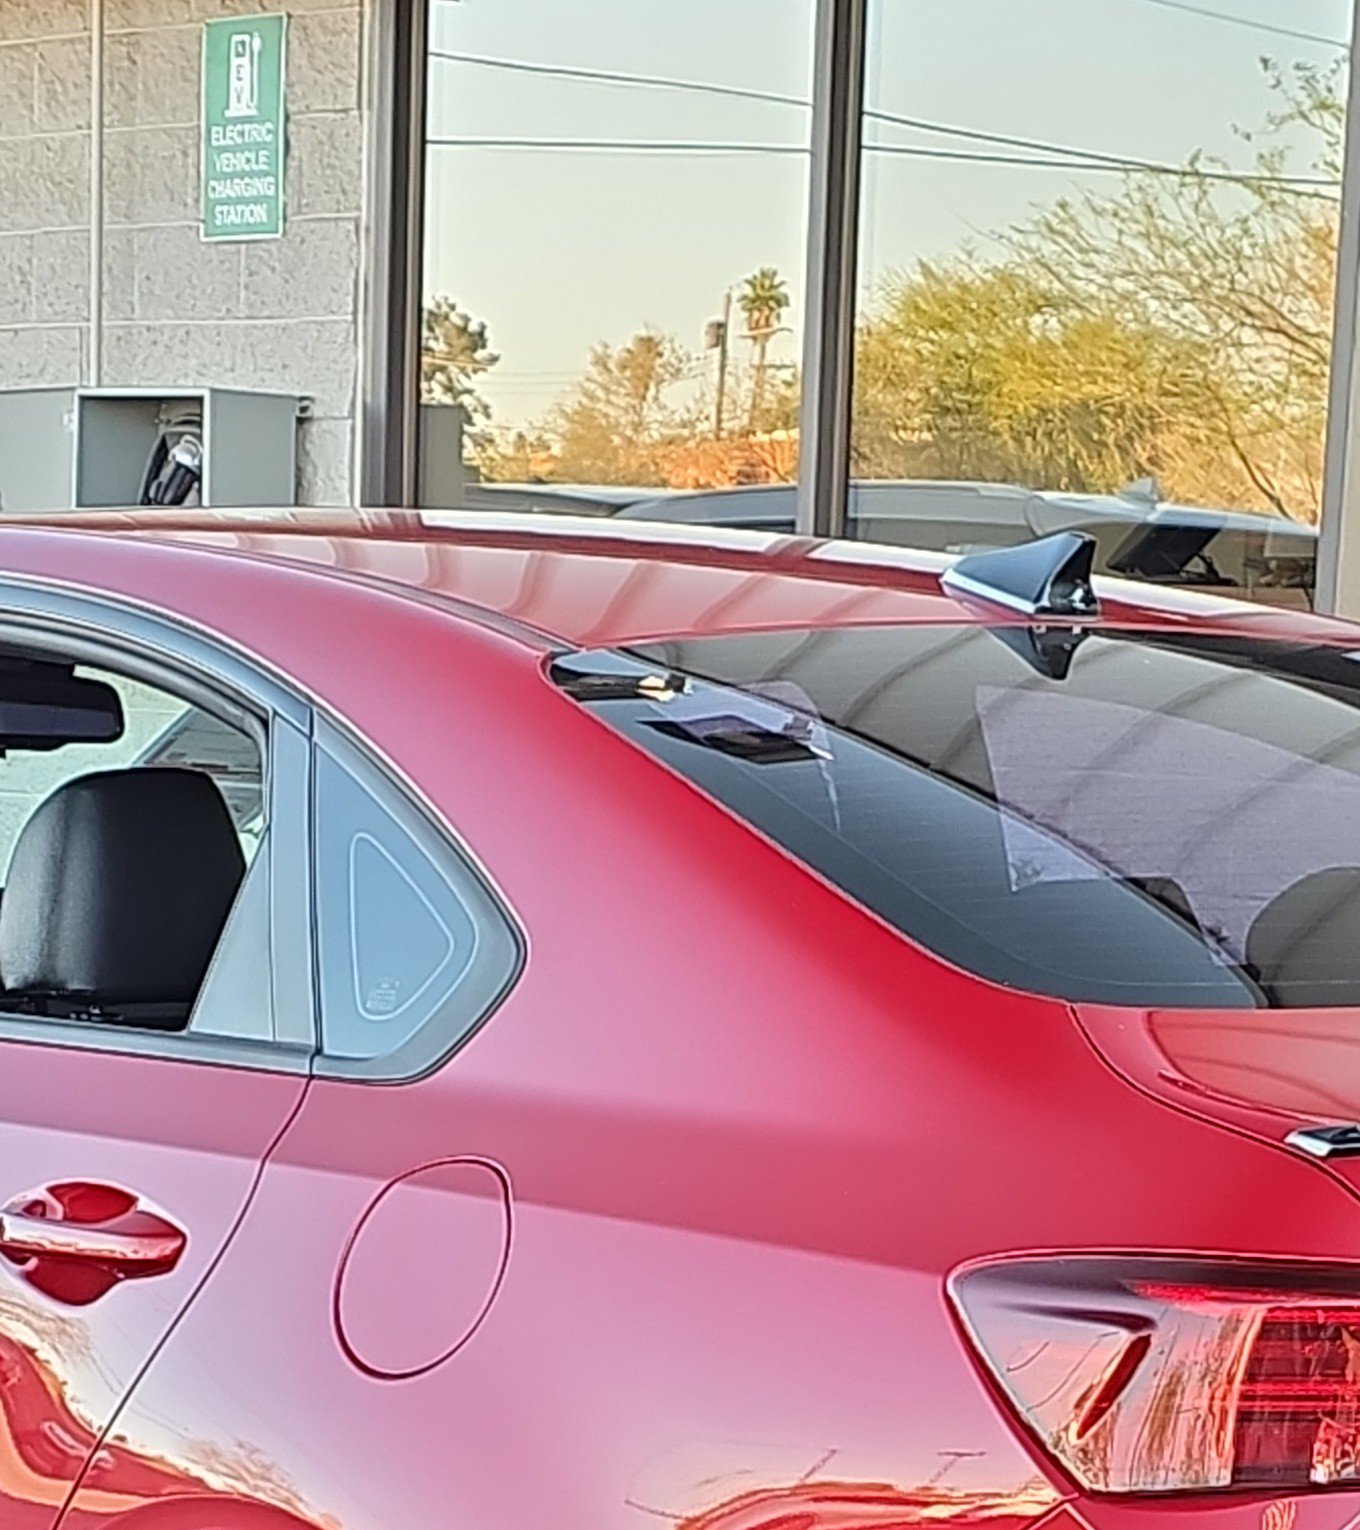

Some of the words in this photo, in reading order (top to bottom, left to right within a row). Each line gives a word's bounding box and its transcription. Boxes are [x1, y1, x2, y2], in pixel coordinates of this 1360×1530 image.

[211, 123, 273, 146] ELECTRIC
[215, 150, 270, 172] VEHICLE
[209, 176, 275, 198] CHARGING
[214, 203, 267, 226] STATION
